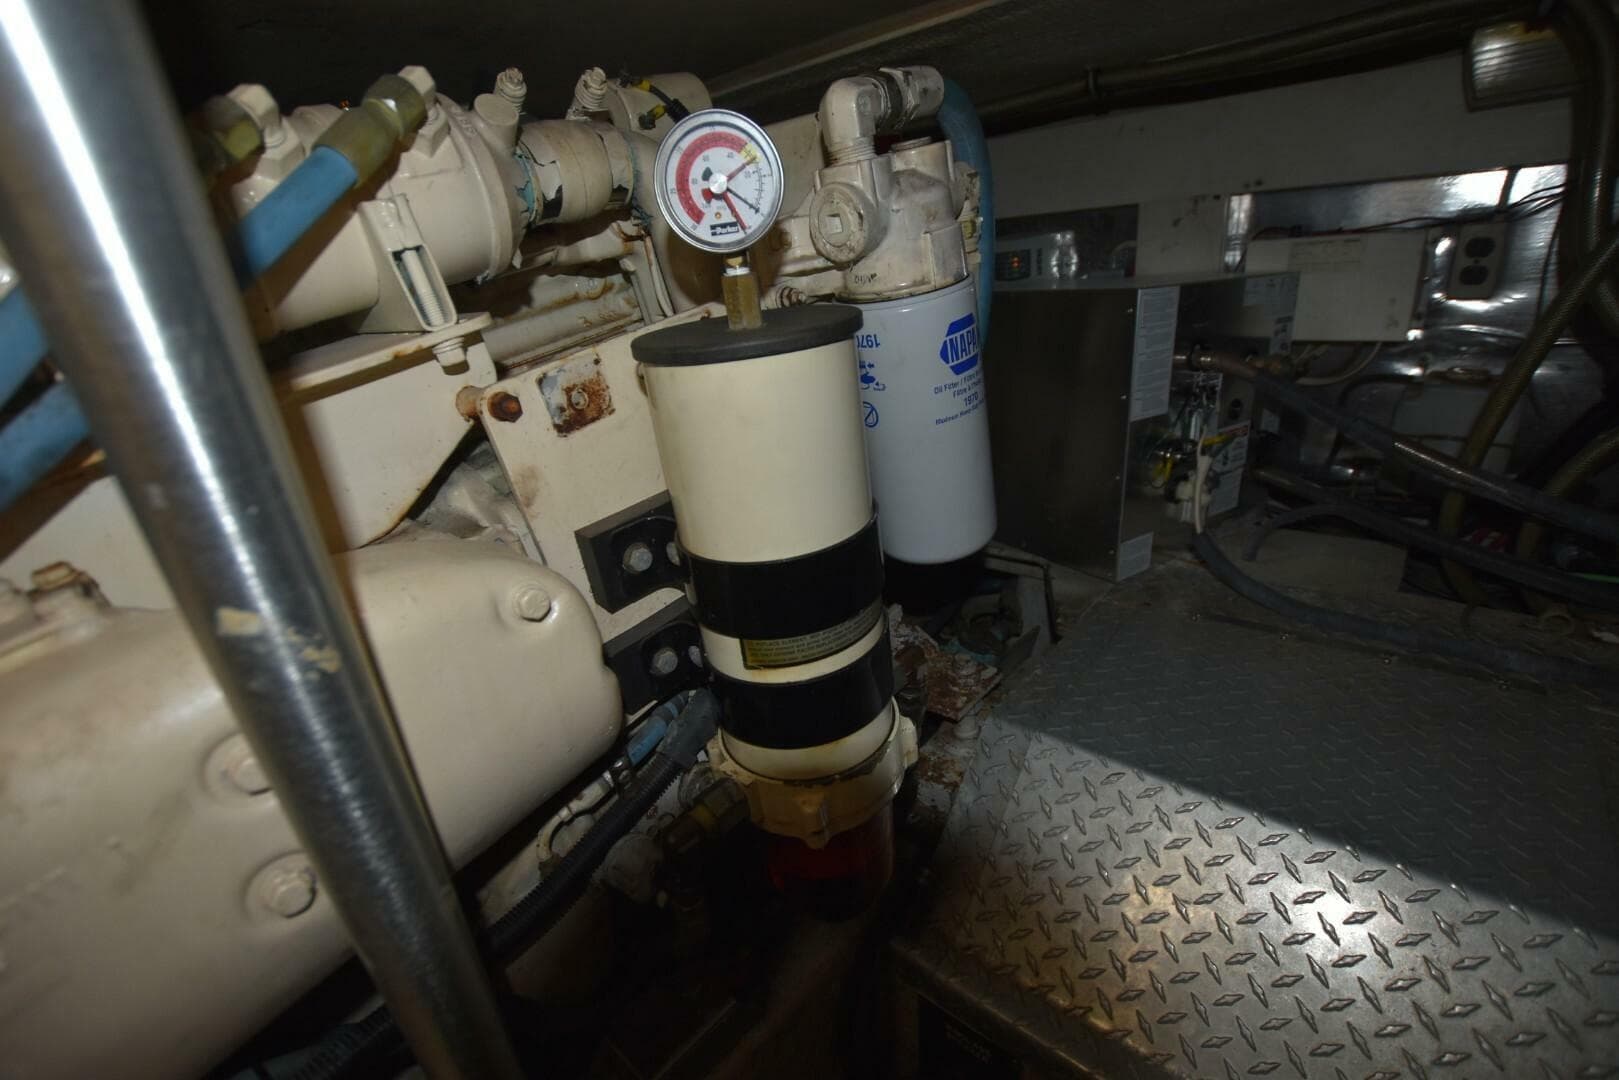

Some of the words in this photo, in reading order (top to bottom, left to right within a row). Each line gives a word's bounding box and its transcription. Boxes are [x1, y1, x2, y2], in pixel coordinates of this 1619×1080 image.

[949, 327, 978, 363] NAPA
[934, 385, 943, 394] Oil
[964, 392, 979, 406] 1970
